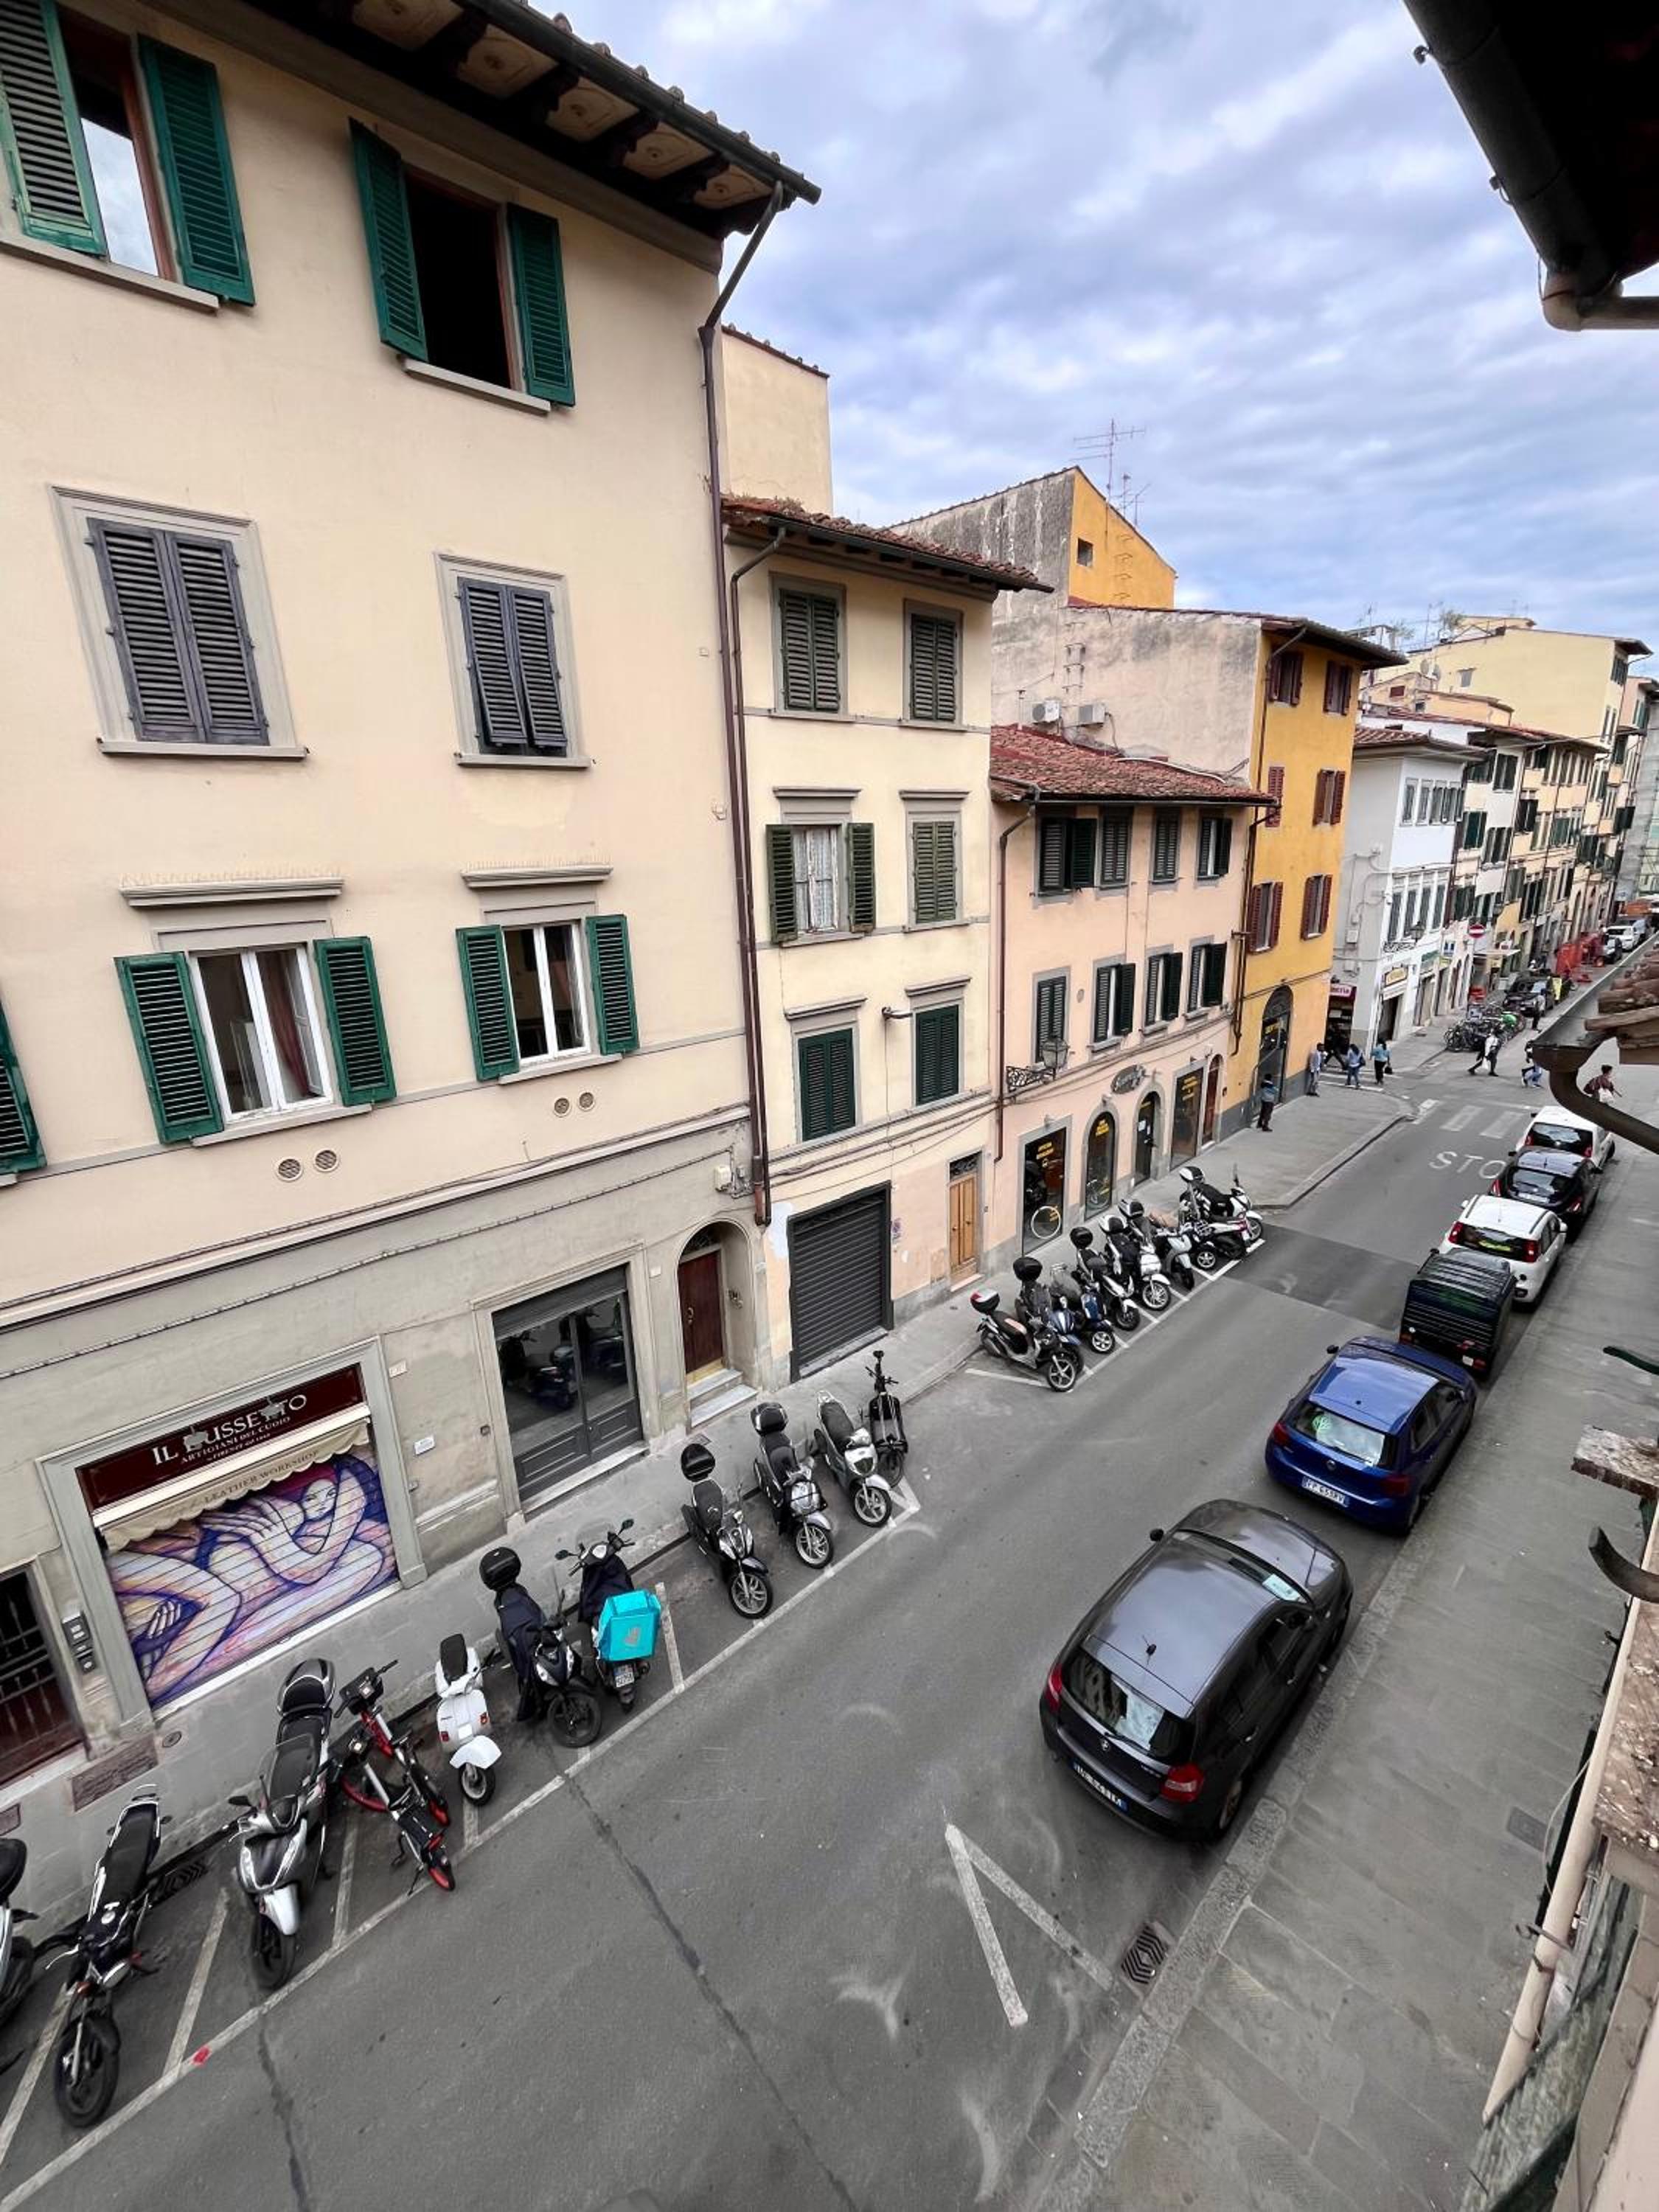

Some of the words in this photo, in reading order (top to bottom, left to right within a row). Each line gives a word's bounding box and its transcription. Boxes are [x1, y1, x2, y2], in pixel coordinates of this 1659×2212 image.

[1428, 1151, 1506, 1179] STO
[152, 1446, 178, 1465] IL
[181, 1436, 238, 1464] ARTIGIANI
[240, 1430, 257, 1441] DEL
[259, 1416, 291, 1433] CUOIO
[204, 1475, 257, 1503] LEATHER
[260, 1450, 319, 1479] WORKSHOP
